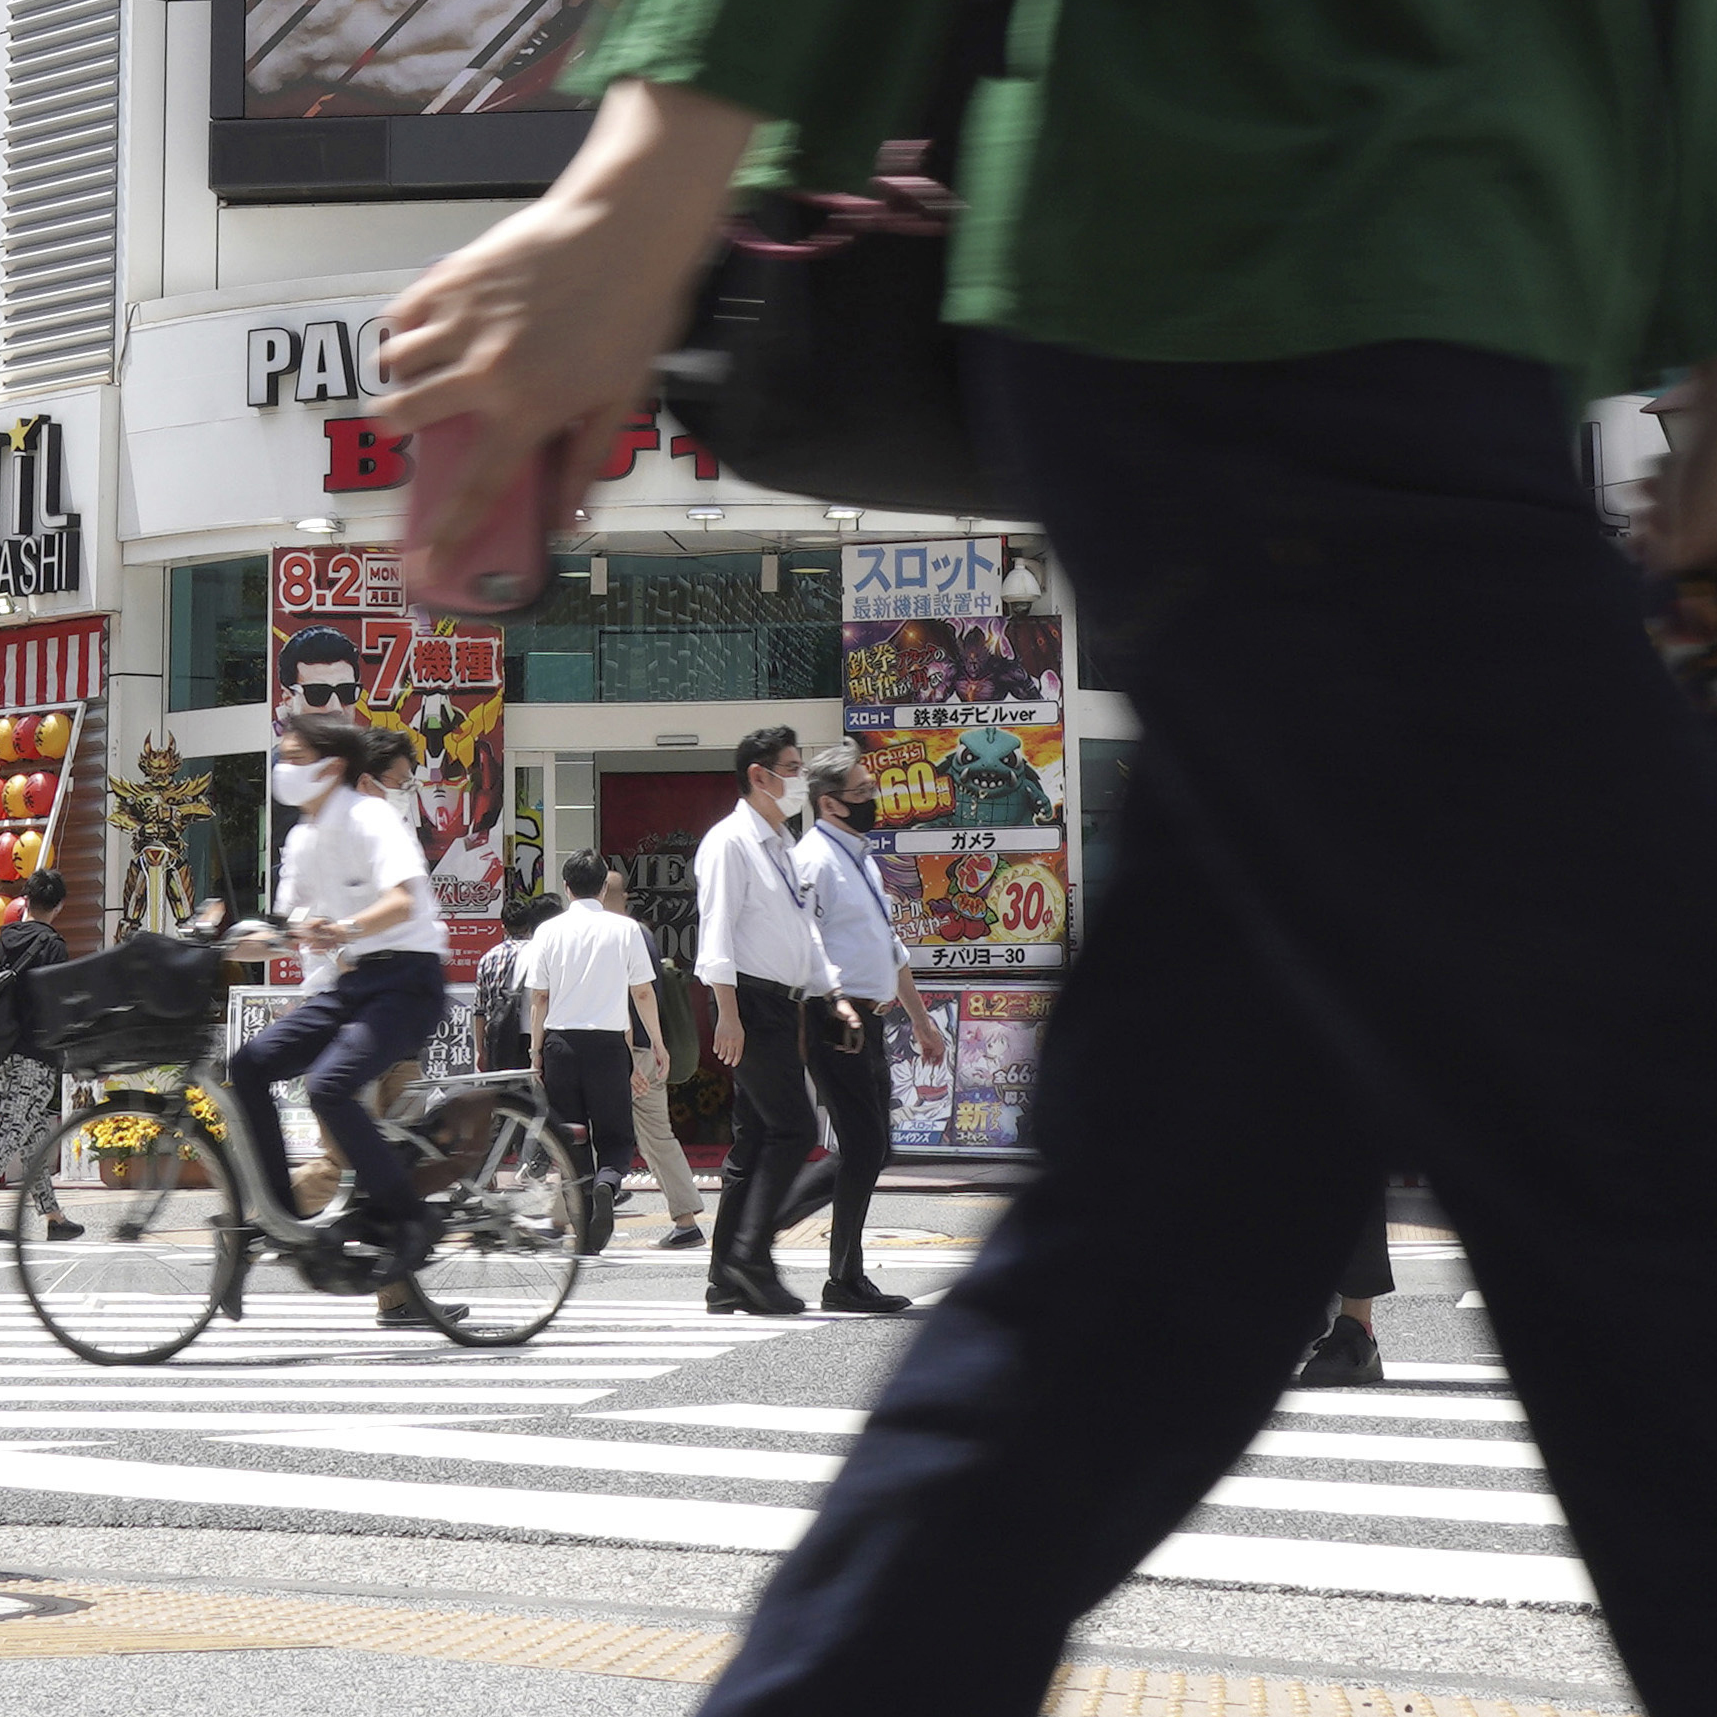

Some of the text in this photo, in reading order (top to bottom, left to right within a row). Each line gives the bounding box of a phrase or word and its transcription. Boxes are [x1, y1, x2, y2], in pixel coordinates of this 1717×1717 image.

[370, 565, 400, 582] MON
[853, 540, 994, 593] スロット
[282, 555, 361, 606] 8.2
[849, 711, 891, 727] スロット
[914, 706, 1036, 728] 鉄拳4デビルver
[951, 832, 996, 850] ガメラ
